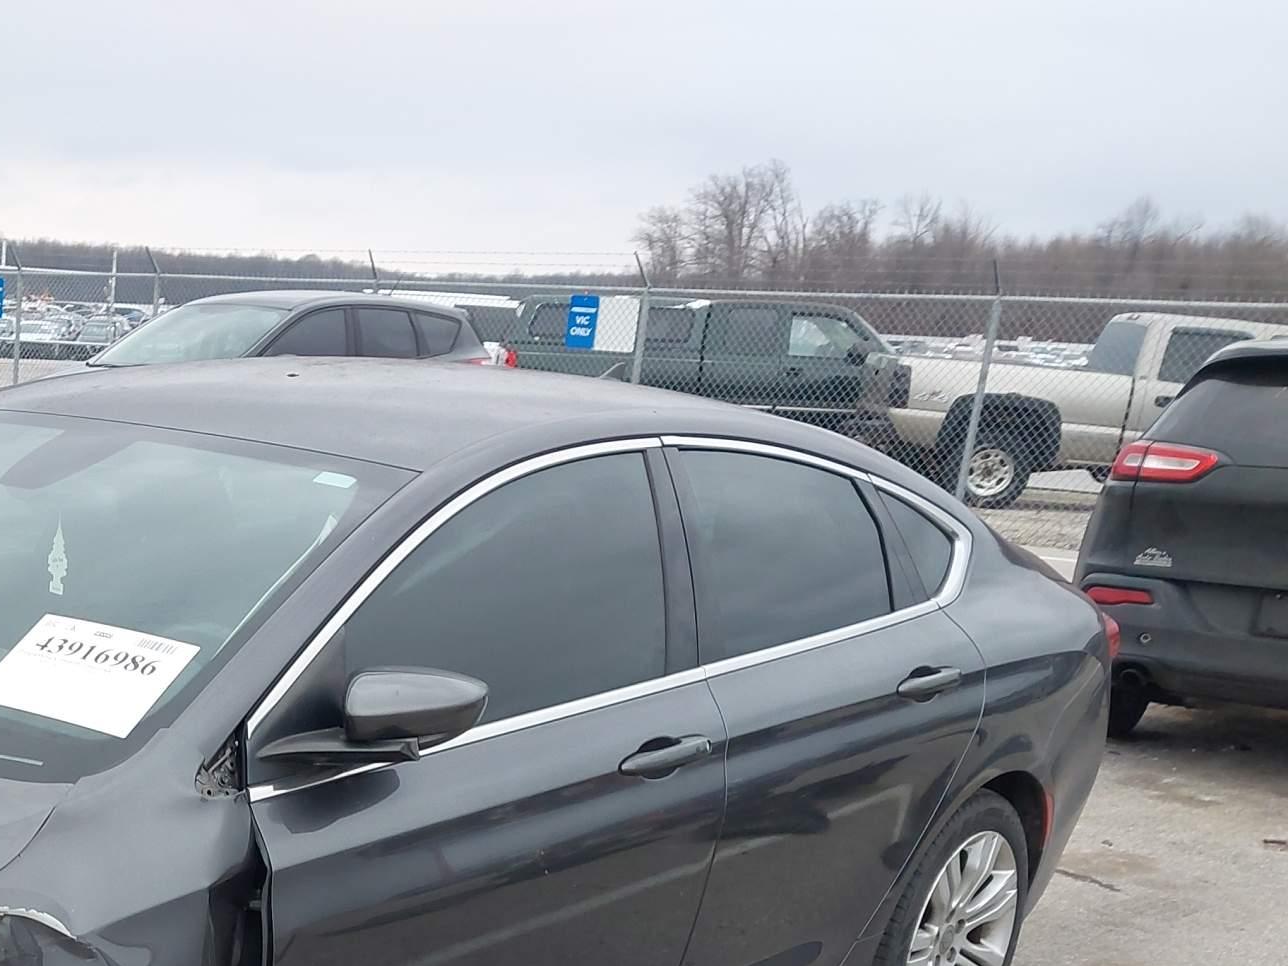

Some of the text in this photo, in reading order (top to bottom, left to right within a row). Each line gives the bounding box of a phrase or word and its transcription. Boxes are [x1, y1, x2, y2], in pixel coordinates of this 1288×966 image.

[575, 315, 591, 325] VIC
[569, 326, 592, 336] ONLY
[35, 636, 161, 676] 43916986
